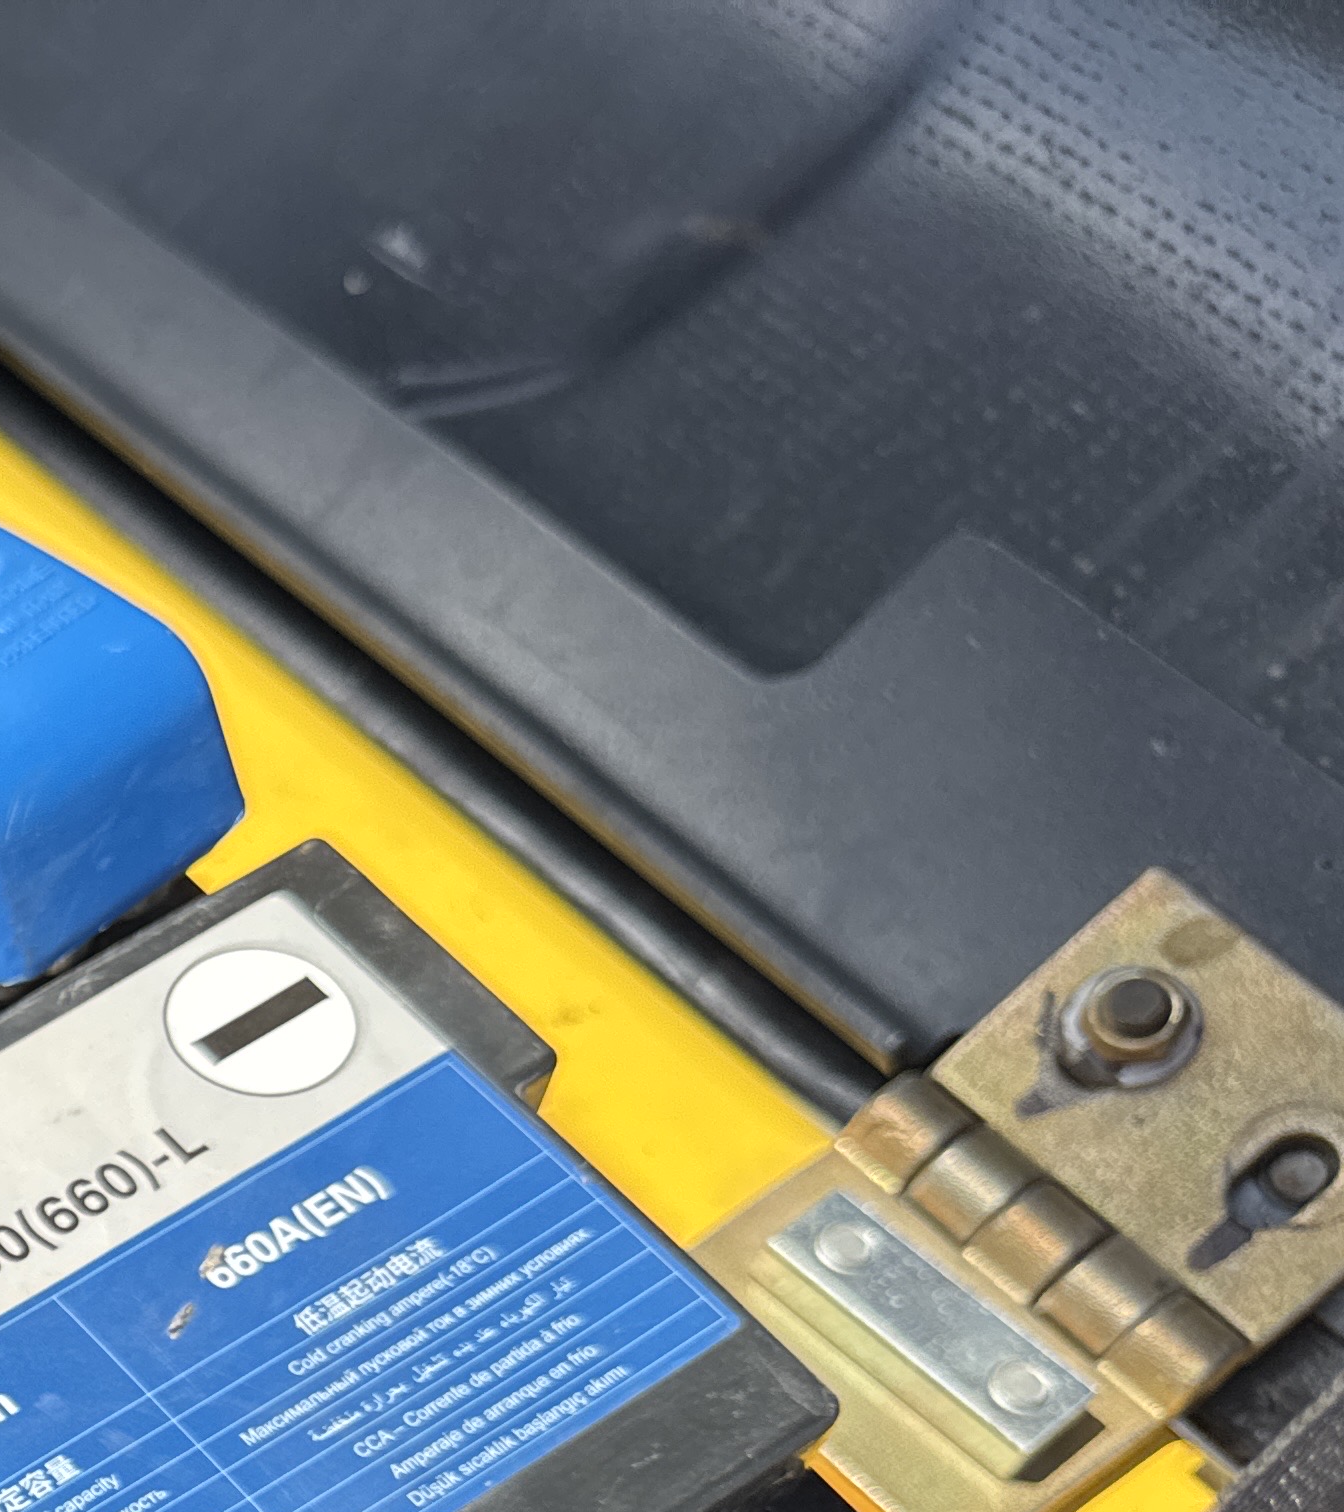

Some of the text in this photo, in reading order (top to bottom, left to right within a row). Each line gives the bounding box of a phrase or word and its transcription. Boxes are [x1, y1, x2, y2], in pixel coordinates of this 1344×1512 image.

[294, 1236, 447, 1337] 低温起动电流
[287, 1345, 326, 1377] Cold
[326, 1312, 390, 1366] cranking
[238, 1369, 359, 1447] Максимальный
[352, 1429, 395, 1459] CCA
[403, 1380, 471, 1428] Corrente
[469, 1365, 493, 1388] de
[491, 1334, 544, 1379] partida
[389, 1428, 464, 1479] Amperaje
[462, 1412, 486, 1434] de
[483, 1373, 552, 1424] arranque
[548, 1360, 571, 1380] en
